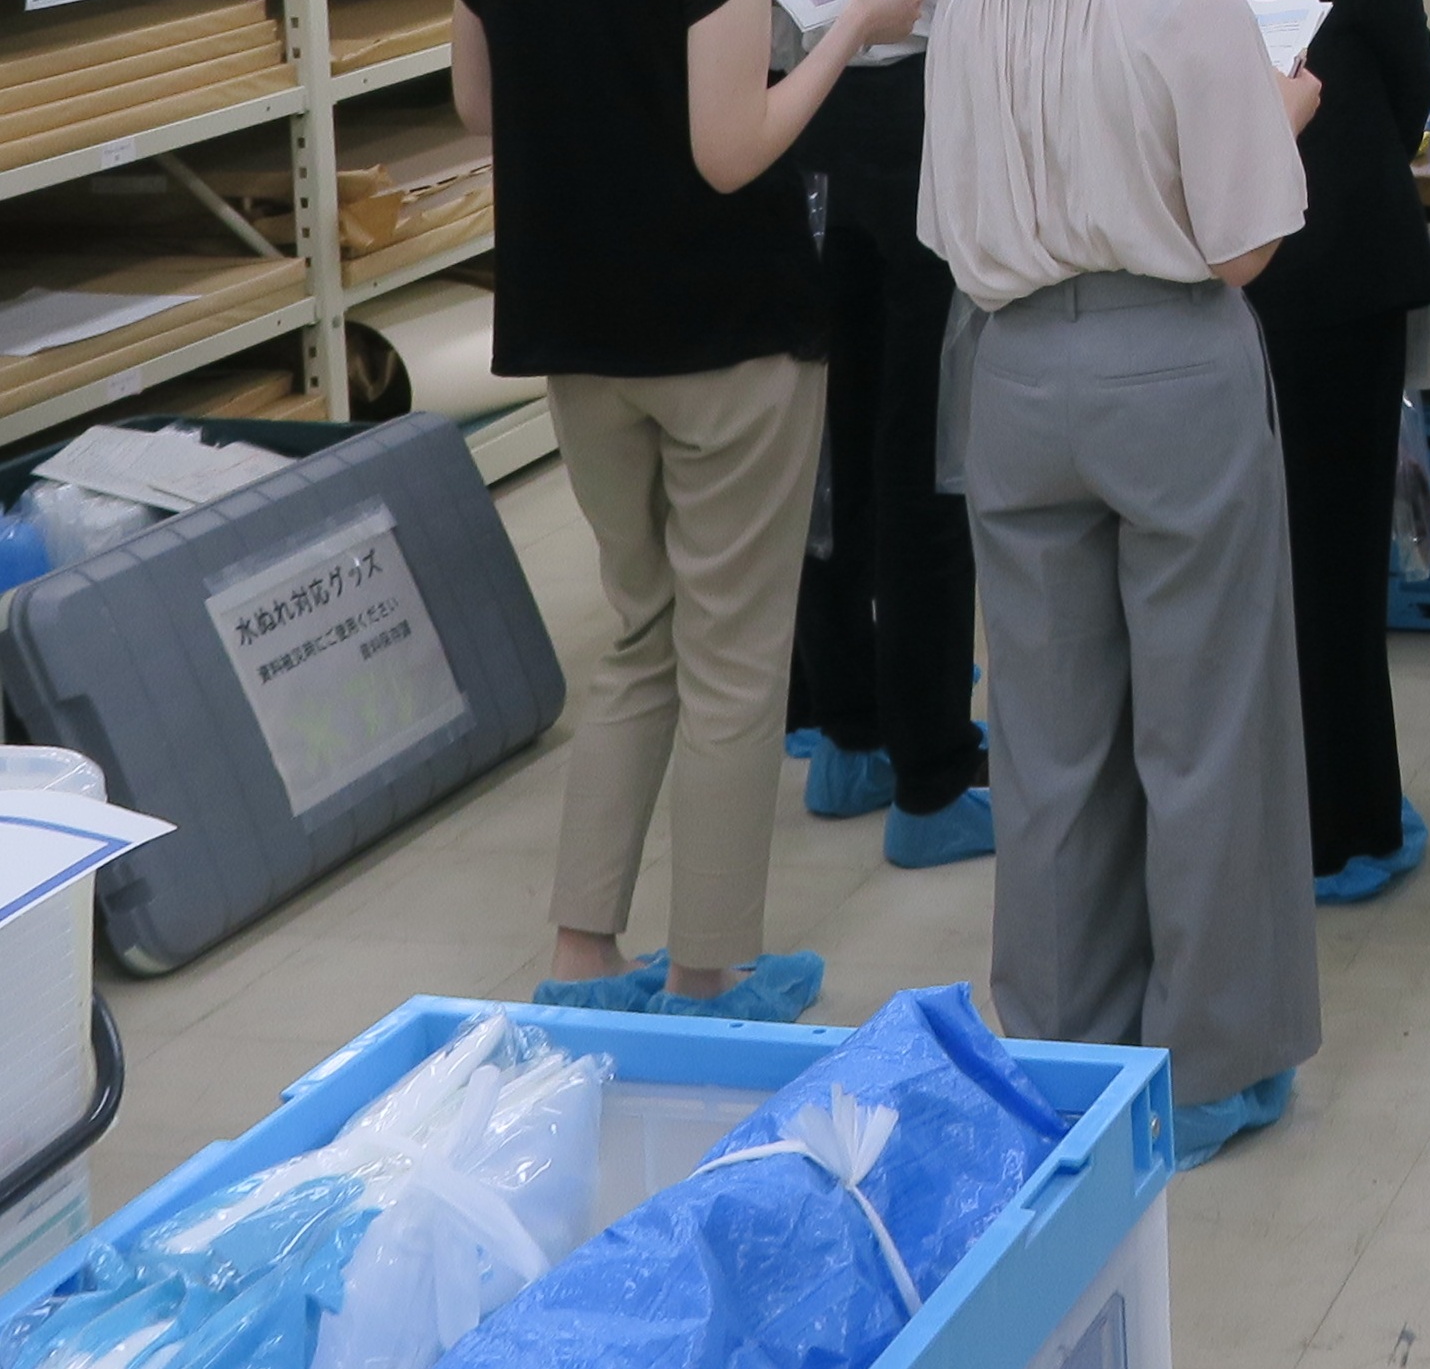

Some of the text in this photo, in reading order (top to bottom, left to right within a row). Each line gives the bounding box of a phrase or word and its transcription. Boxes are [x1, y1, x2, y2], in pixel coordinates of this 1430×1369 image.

[235, 547, 384, 647] 水ぬれ対応グッズ
